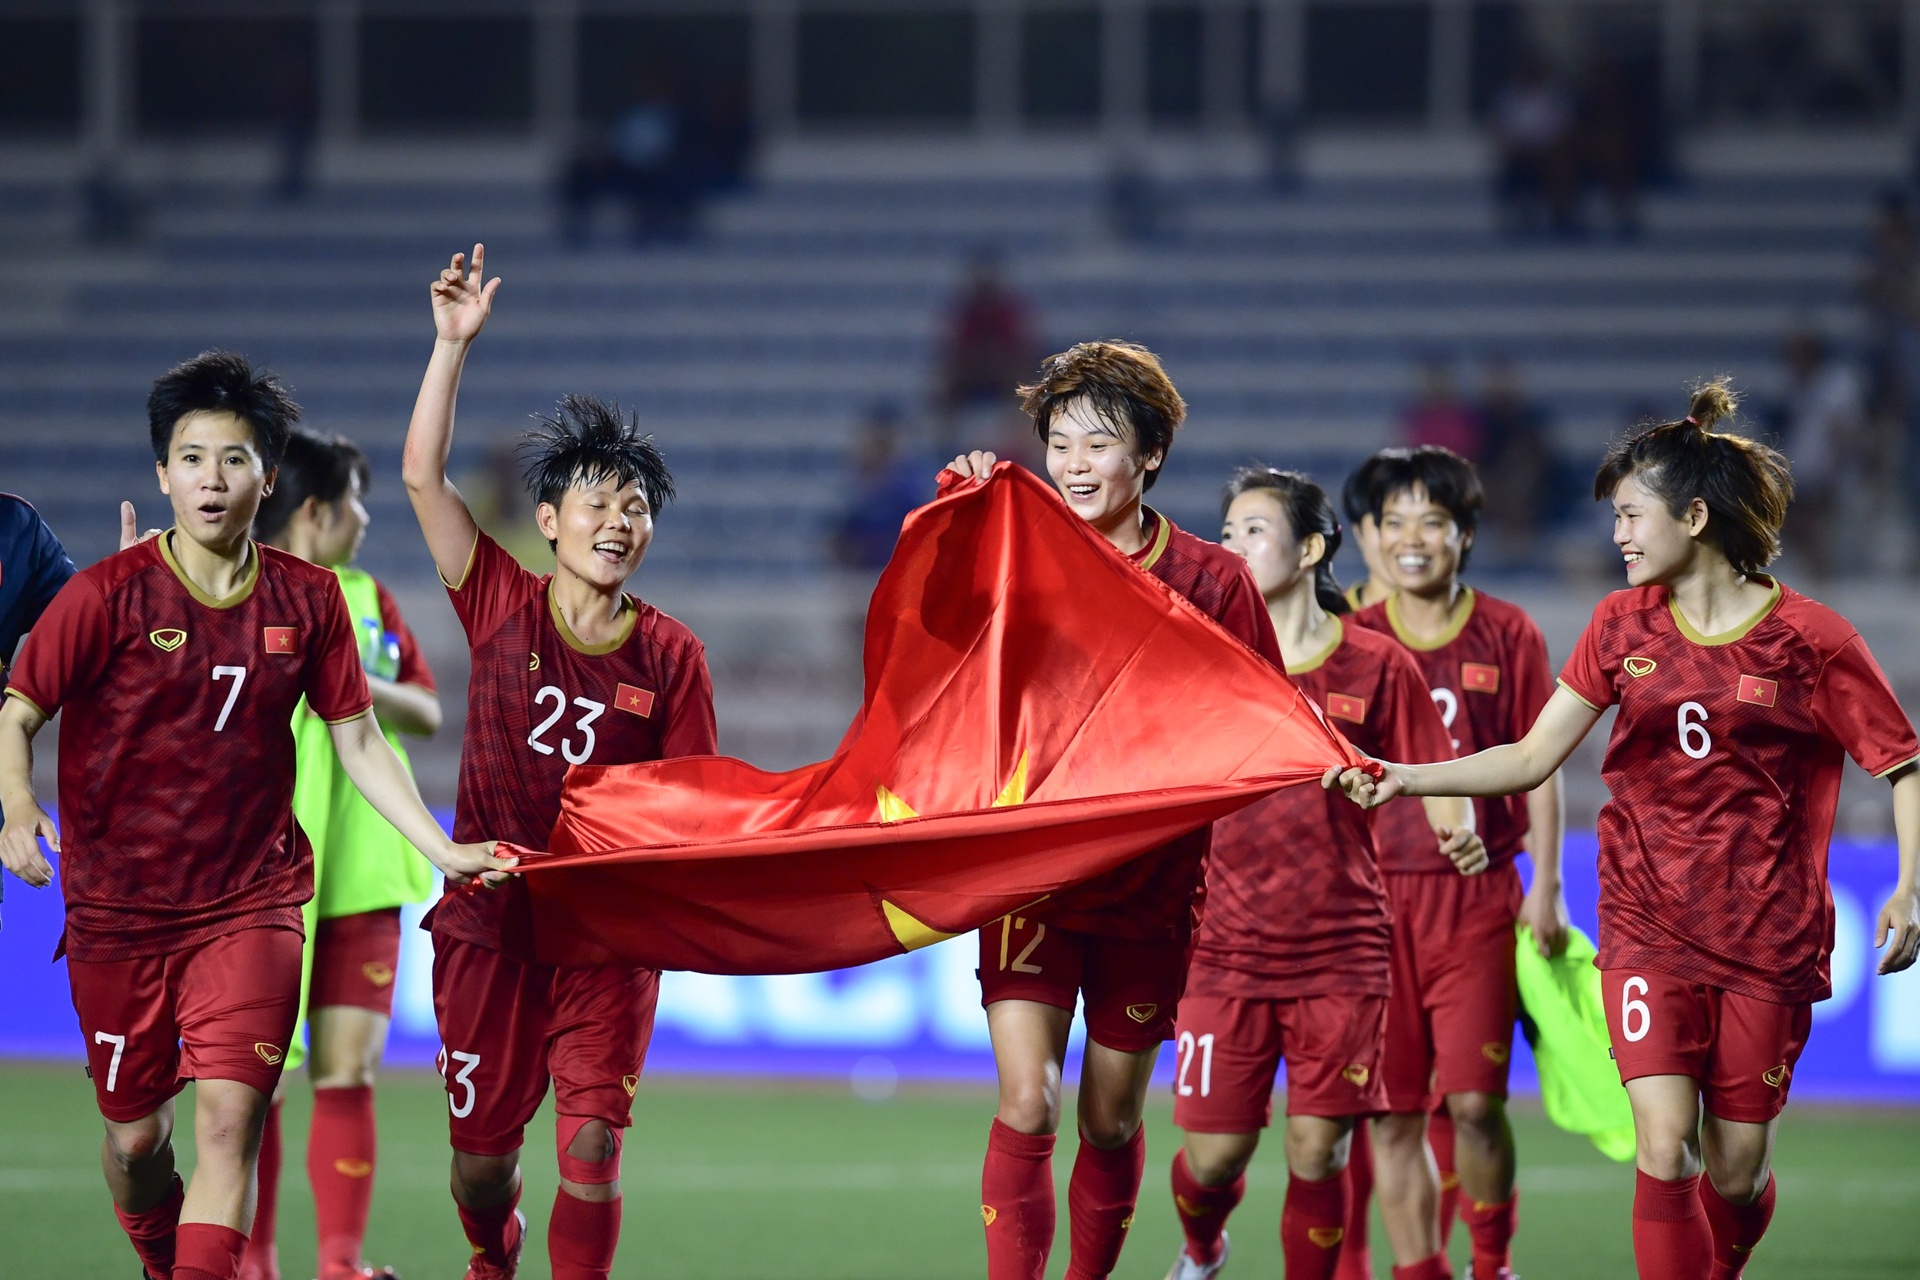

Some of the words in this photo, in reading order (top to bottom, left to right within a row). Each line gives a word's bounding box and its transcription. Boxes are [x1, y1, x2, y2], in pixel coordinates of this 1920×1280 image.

[212, 665, 246, 732] 7
[527, 685, 606, 765] 23
[1677, 701, 1711, 759] 6
[999, 914, 1046, 975] 12
[1622, 975, 1651, 1043] 6
[94, 1030, 126, 1092] 7
[1177, 1030, 1215, 1098] 21
